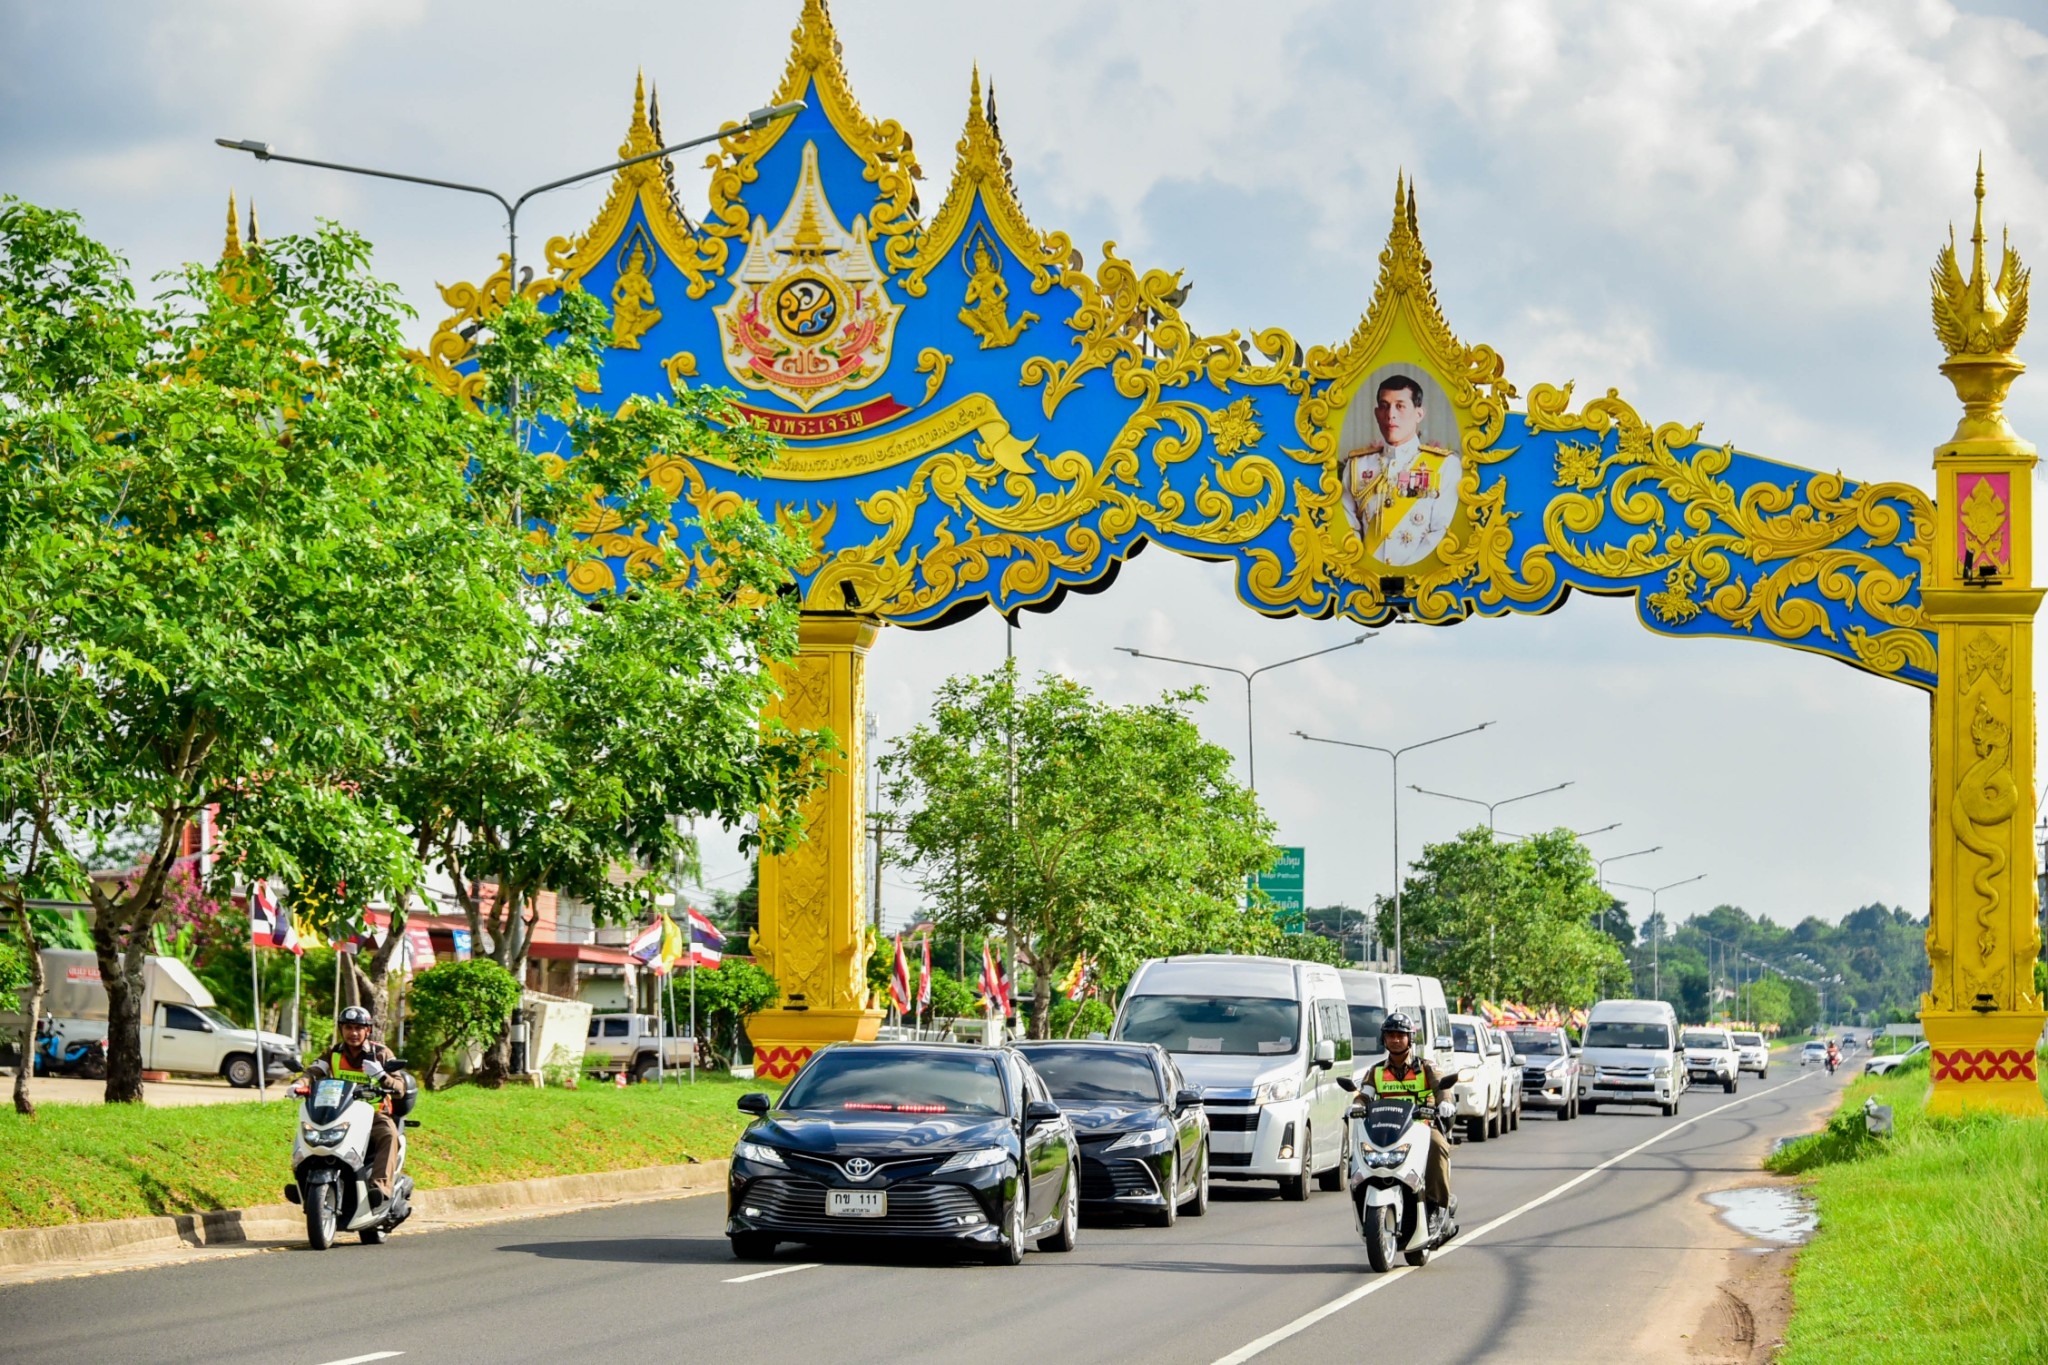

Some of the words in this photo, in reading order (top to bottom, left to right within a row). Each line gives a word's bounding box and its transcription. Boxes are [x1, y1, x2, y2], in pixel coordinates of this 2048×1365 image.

[782, 348, 830, 374] ๗๒
[835, 1194, 851, 1204] กข
[860, 1194, 877, 1205] 111
